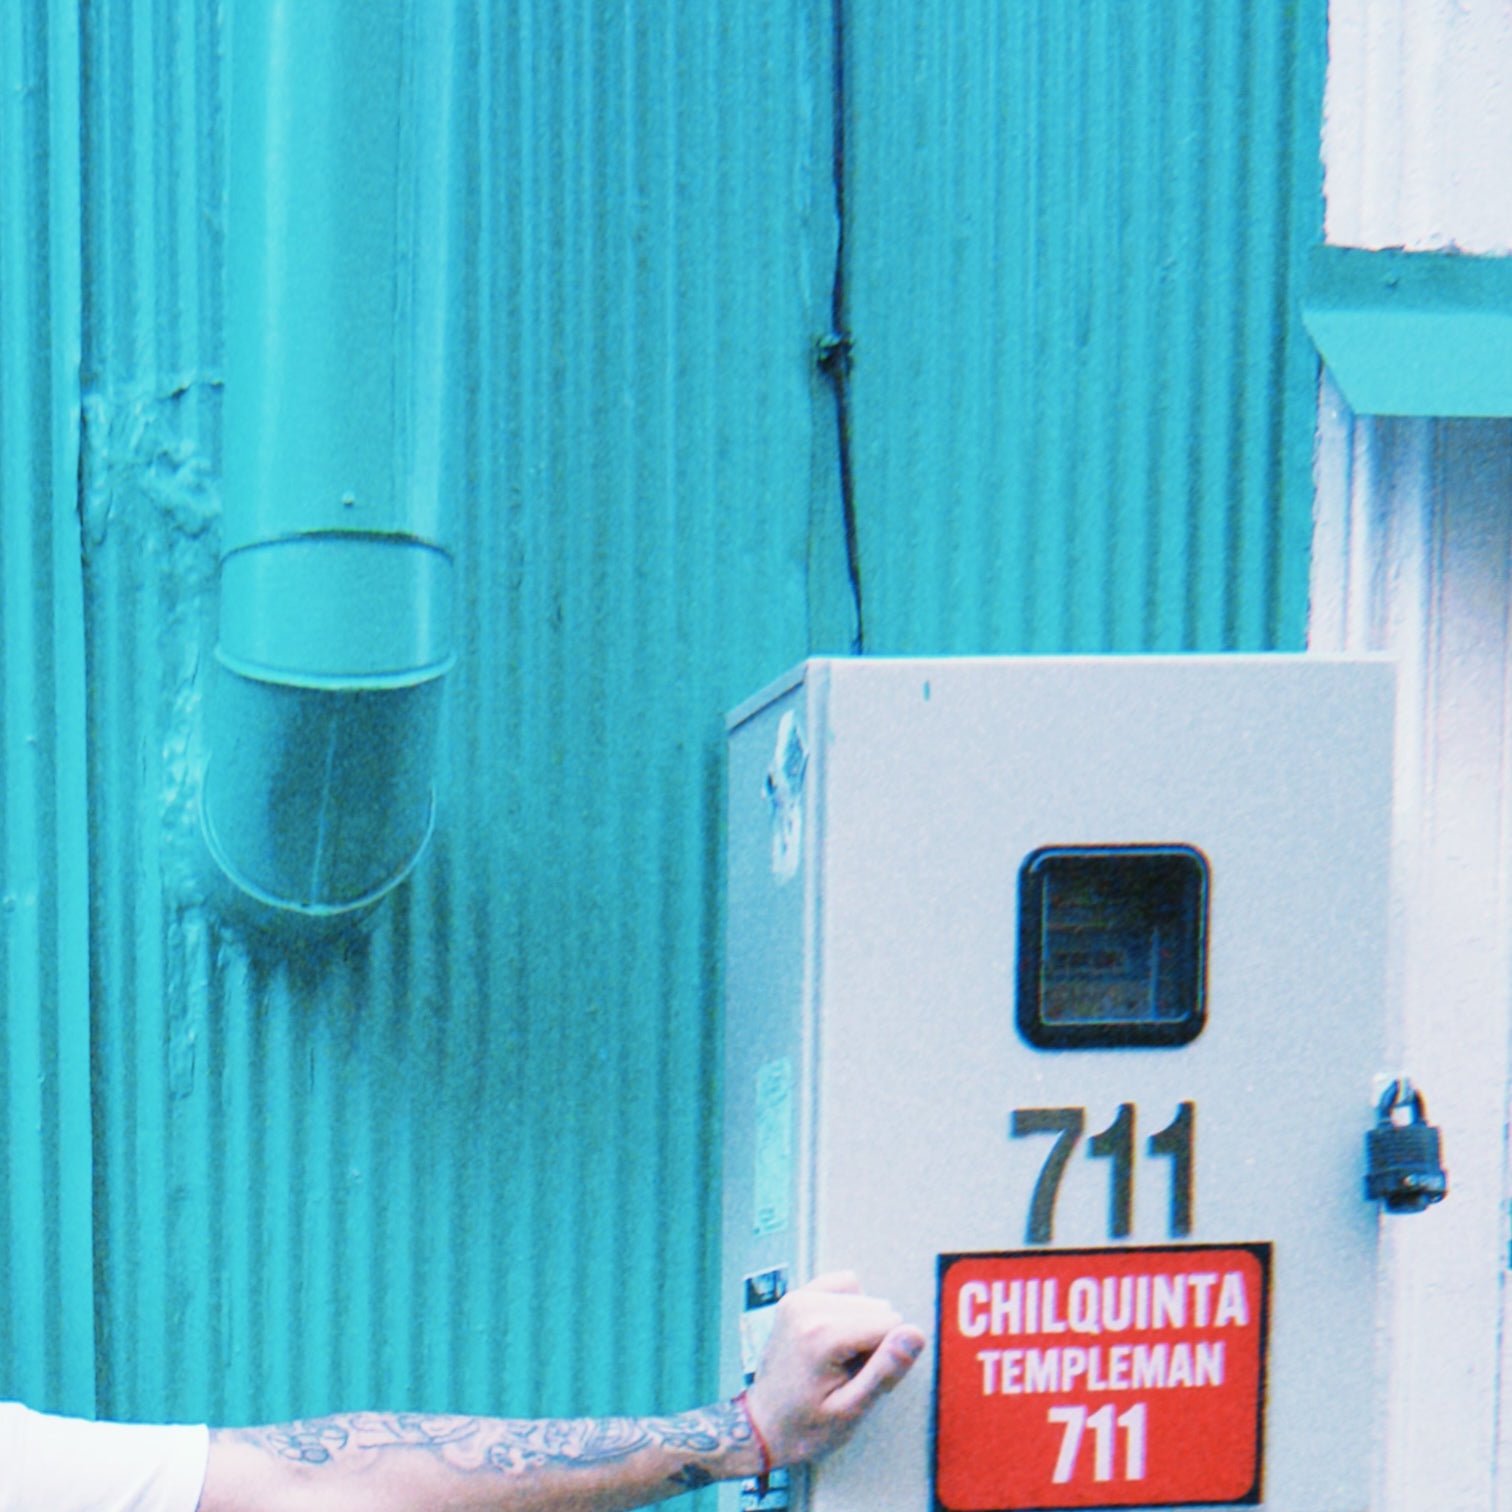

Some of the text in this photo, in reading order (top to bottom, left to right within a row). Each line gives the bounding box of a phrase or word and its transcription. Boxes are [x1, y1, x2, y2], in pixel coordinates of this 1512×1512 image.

[1010, 1101, 1196, 1245] 711
[956, 1272, 1250, 1339] CHILQUINTA
[976, 1342, 1226, 1397] TEMPLEMAN
[1047, 1404, 1148, 1485] 711
